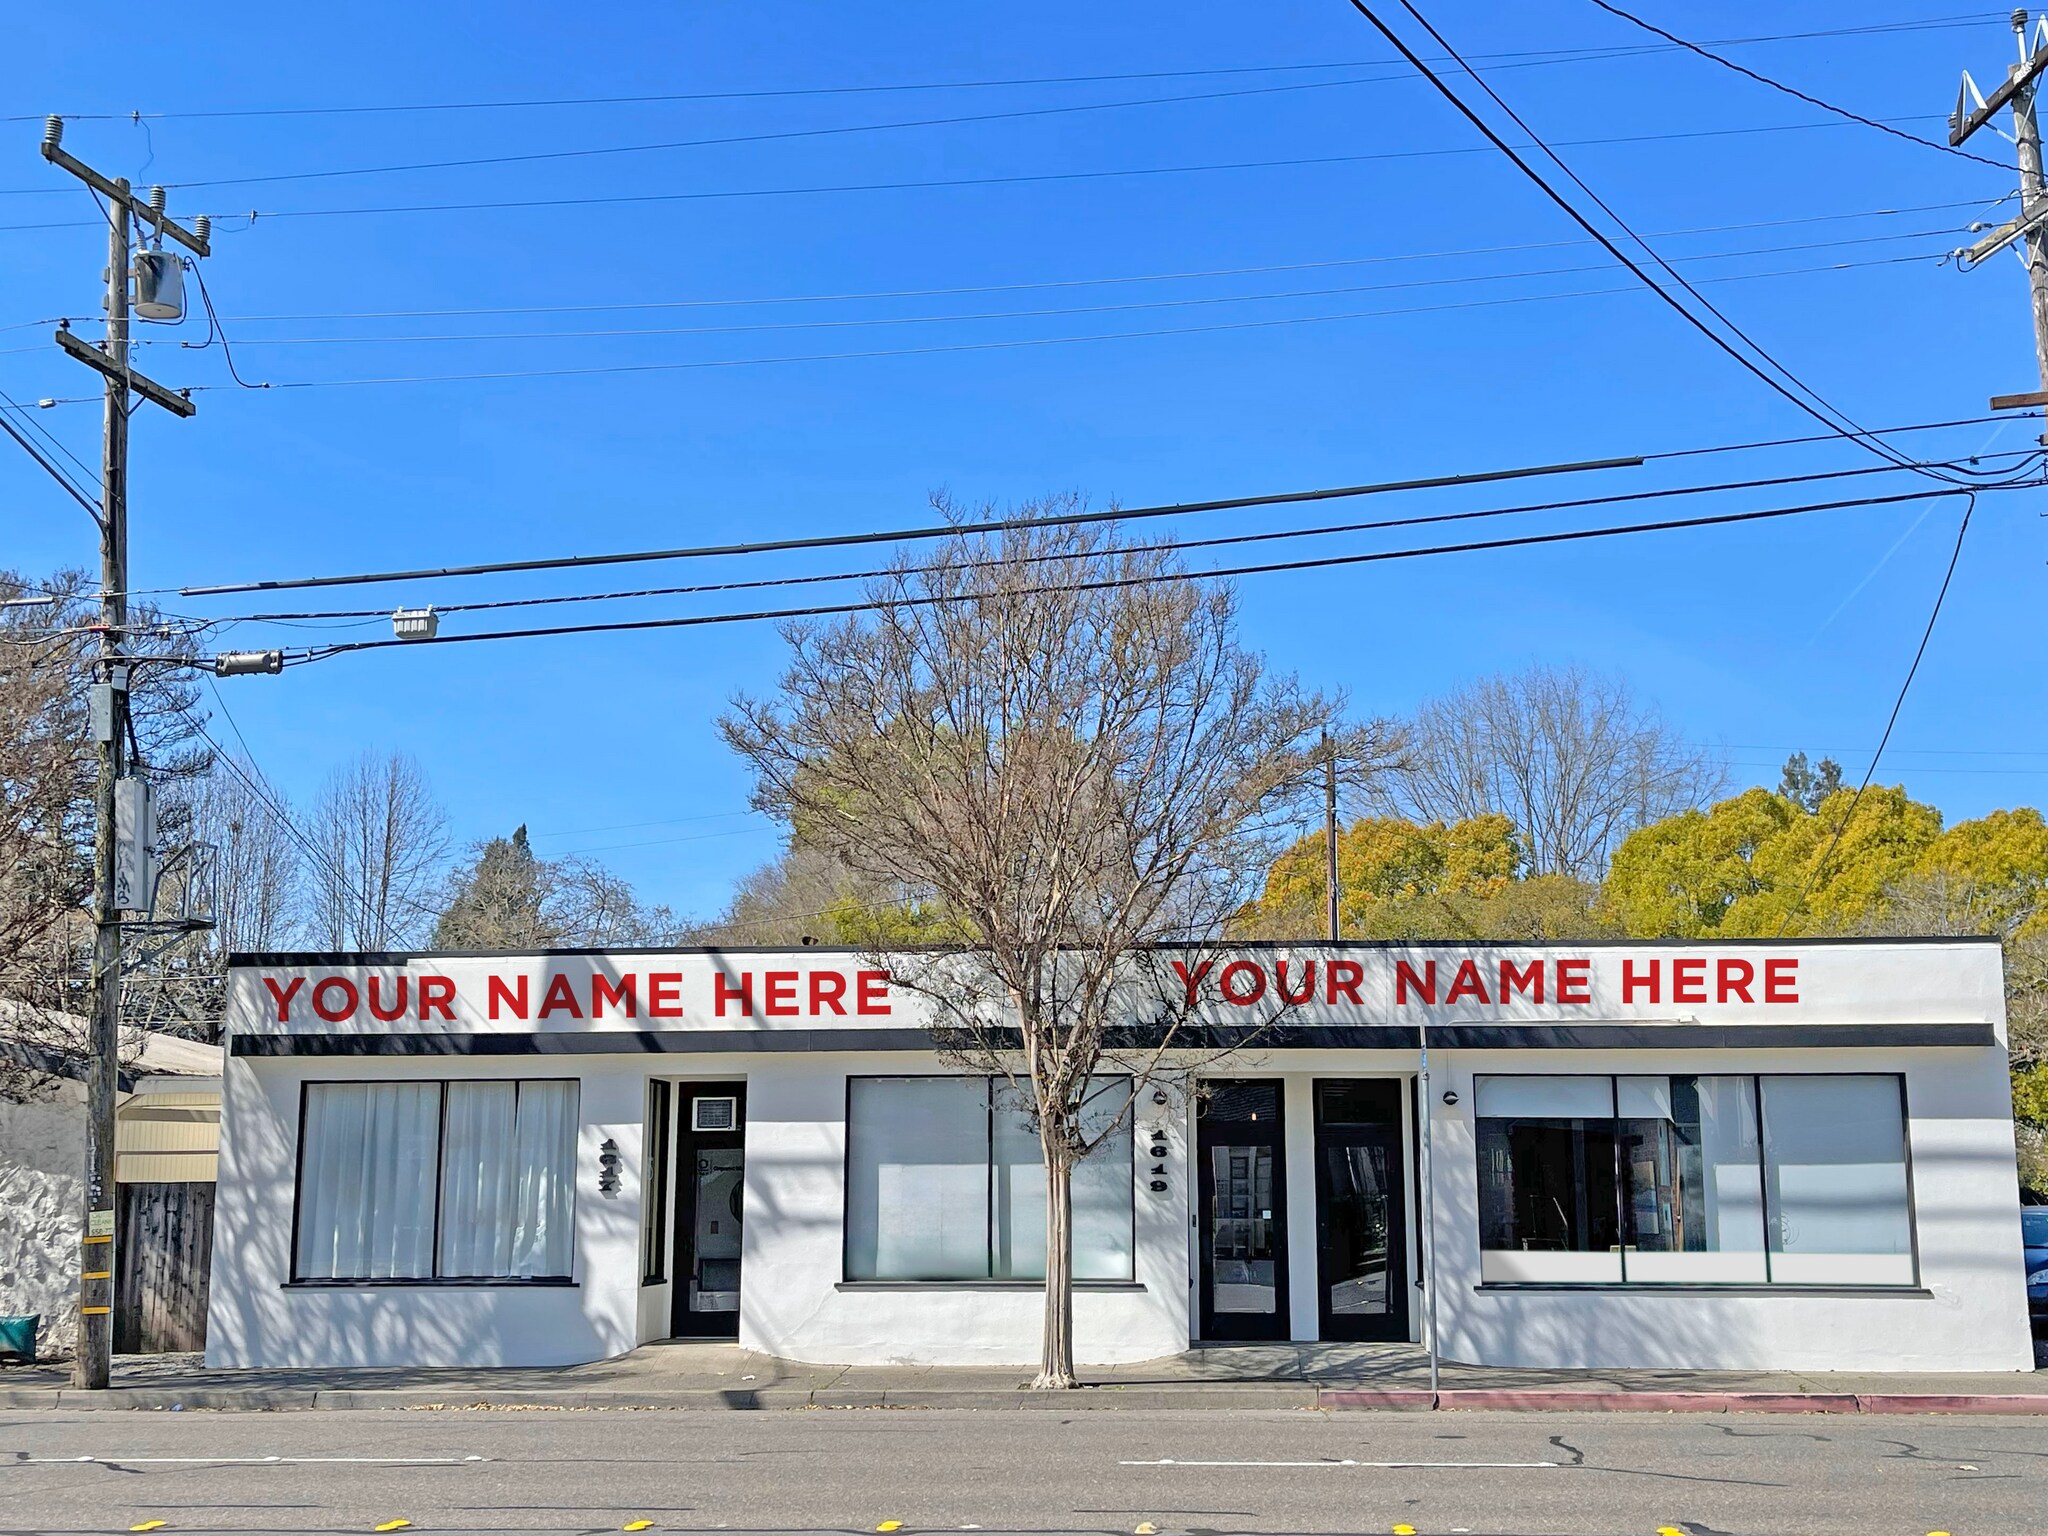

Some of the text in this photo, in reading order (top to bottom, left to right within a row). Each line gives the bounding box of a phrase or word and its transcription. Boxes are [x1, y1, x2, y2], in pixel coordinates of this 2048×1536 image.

[262, 970, 892, 1021] YOUR NAME HERE
[1170, 959, 1799, 1006] YOUR NAME HERE
[1149, 1129, 1168, 1192] 1619
